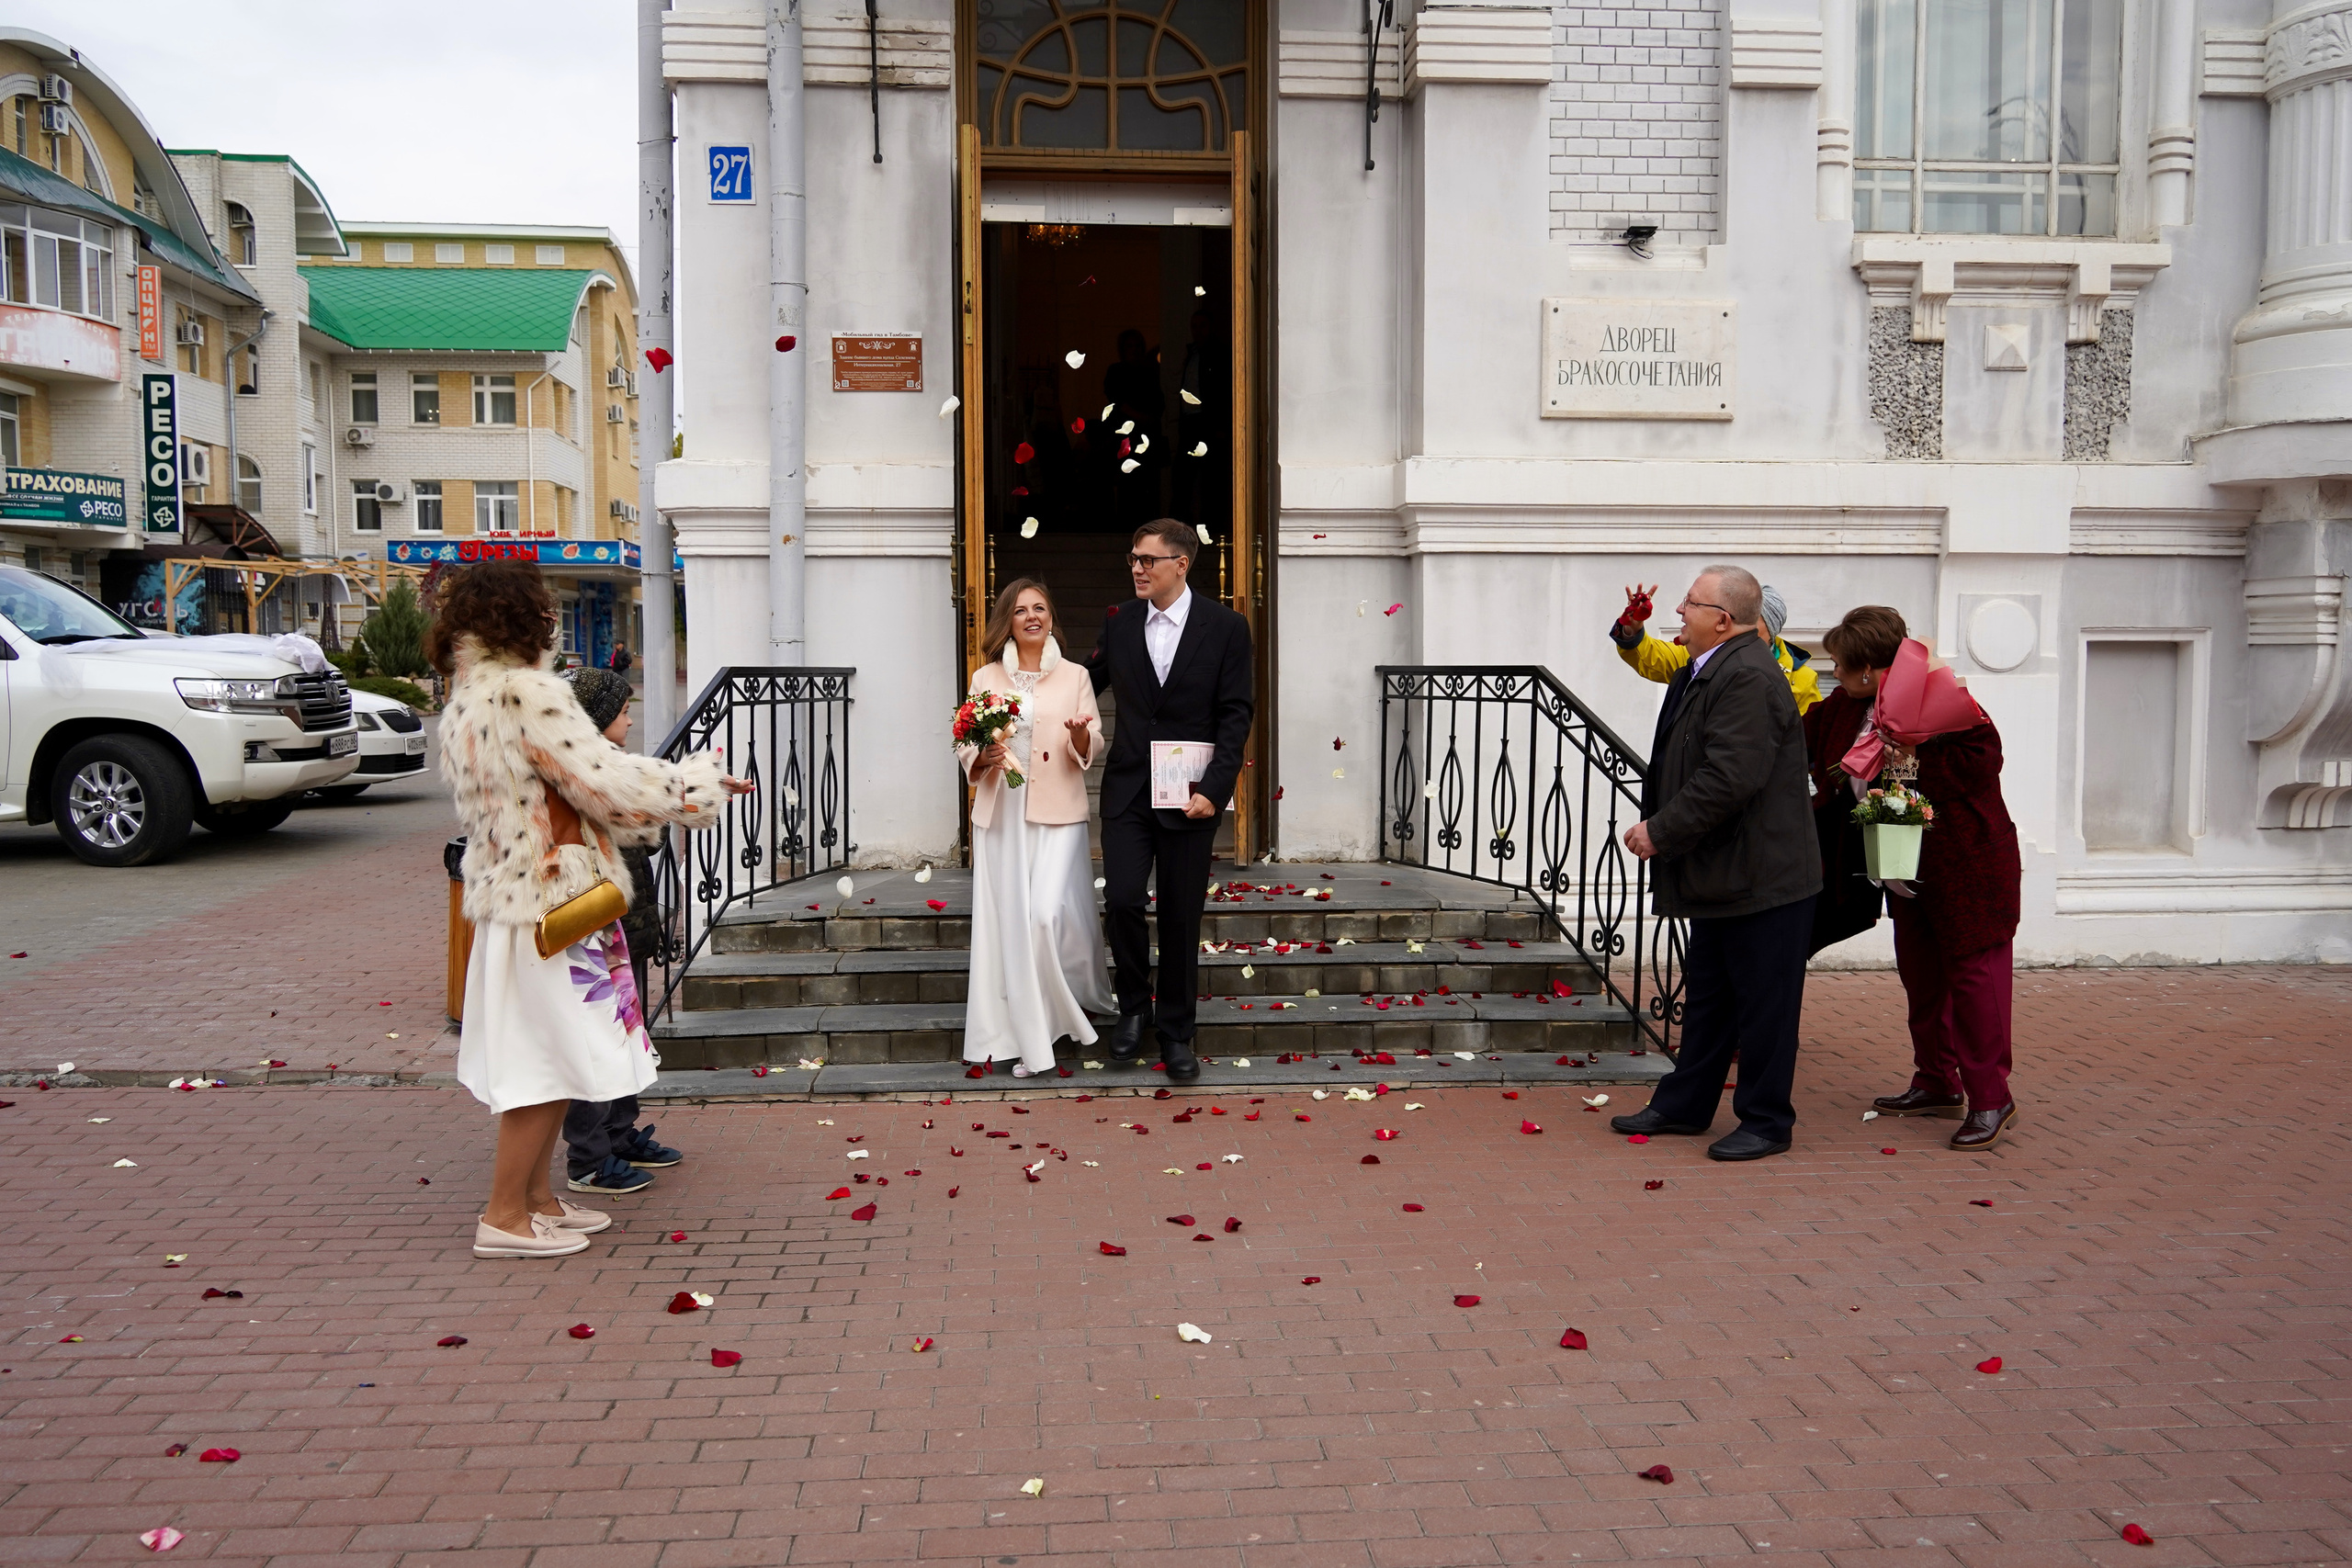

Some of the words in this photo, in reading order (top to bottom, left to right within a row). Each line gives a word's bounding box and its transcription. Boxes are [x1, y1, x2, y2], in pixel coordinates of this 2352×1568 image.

[713, 153, 748, 194] 27
[141, 269, 155, 342] ОПЦИОН
[1599, 324, 1676, 354] ДВОРЕЦ
[1557, 359, 1723, 387] БРАКОСОЧЕТАНИЯ
[150, 380, 175, 488] РЕСО
[94, 501, 123, 518] РЕСО
